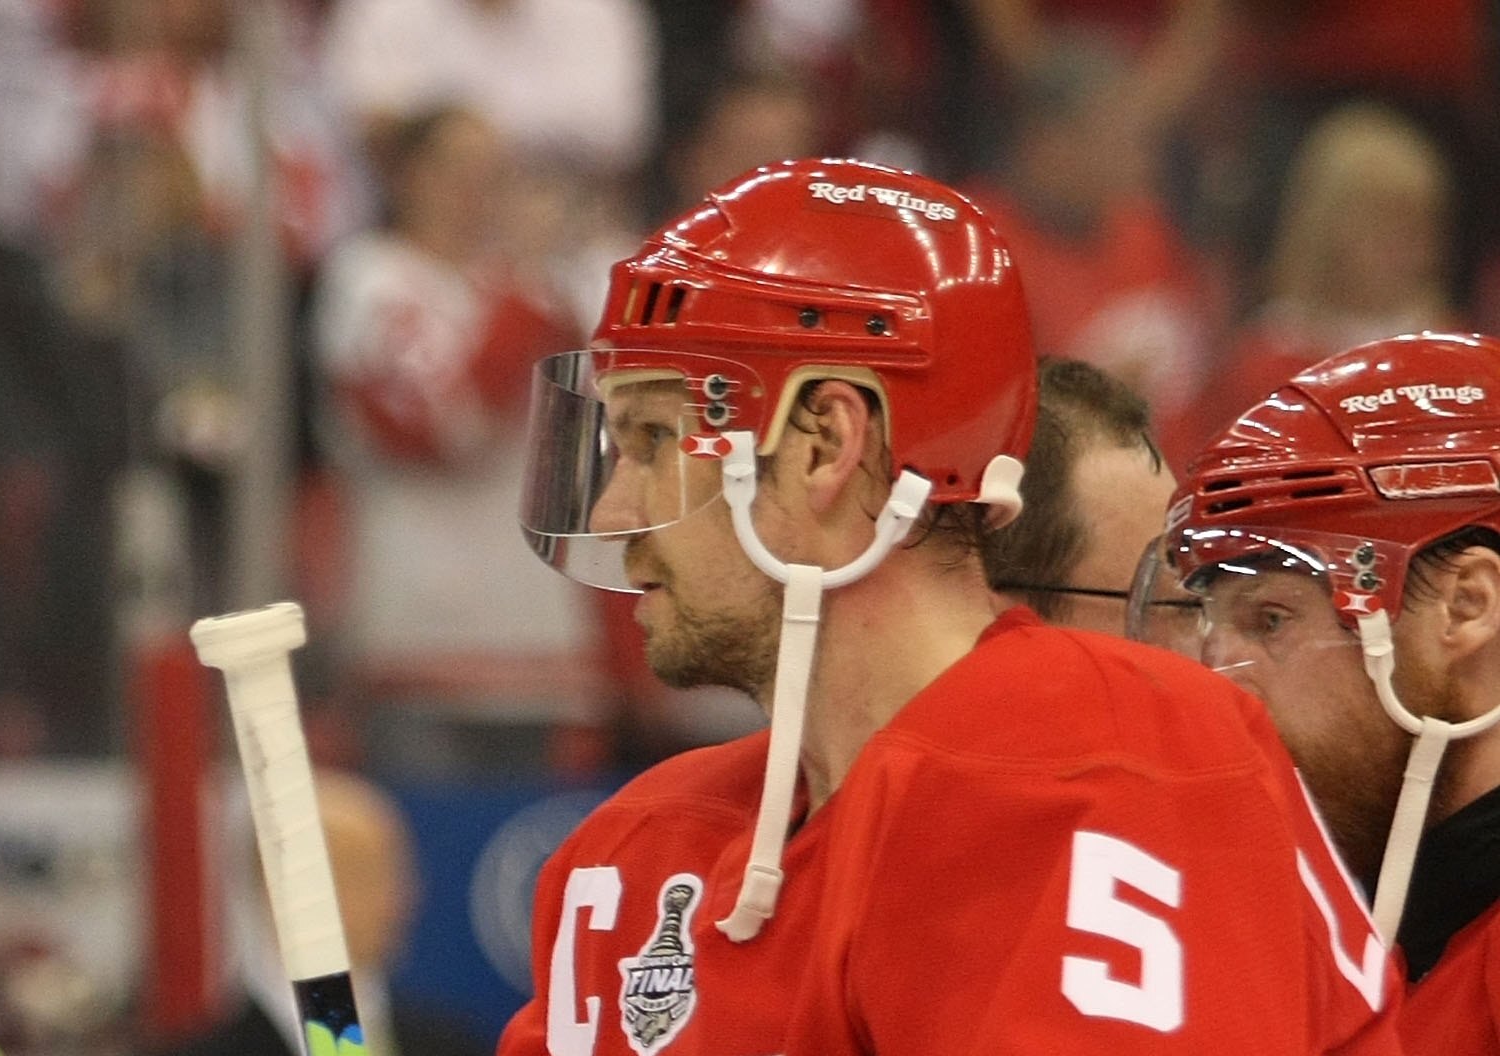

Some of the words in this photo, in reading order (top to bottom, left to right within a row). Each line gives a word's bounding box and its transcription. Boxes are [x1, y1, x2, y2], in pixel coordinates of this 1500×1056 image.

[808, 182, 865, 204] Red
[867, 187, 957, 221] Wings
[1339, 388, 1398, 414] Red
[1396, 383, 1485, 405] Wings
[1061, 830, 1185, 1033] 5
